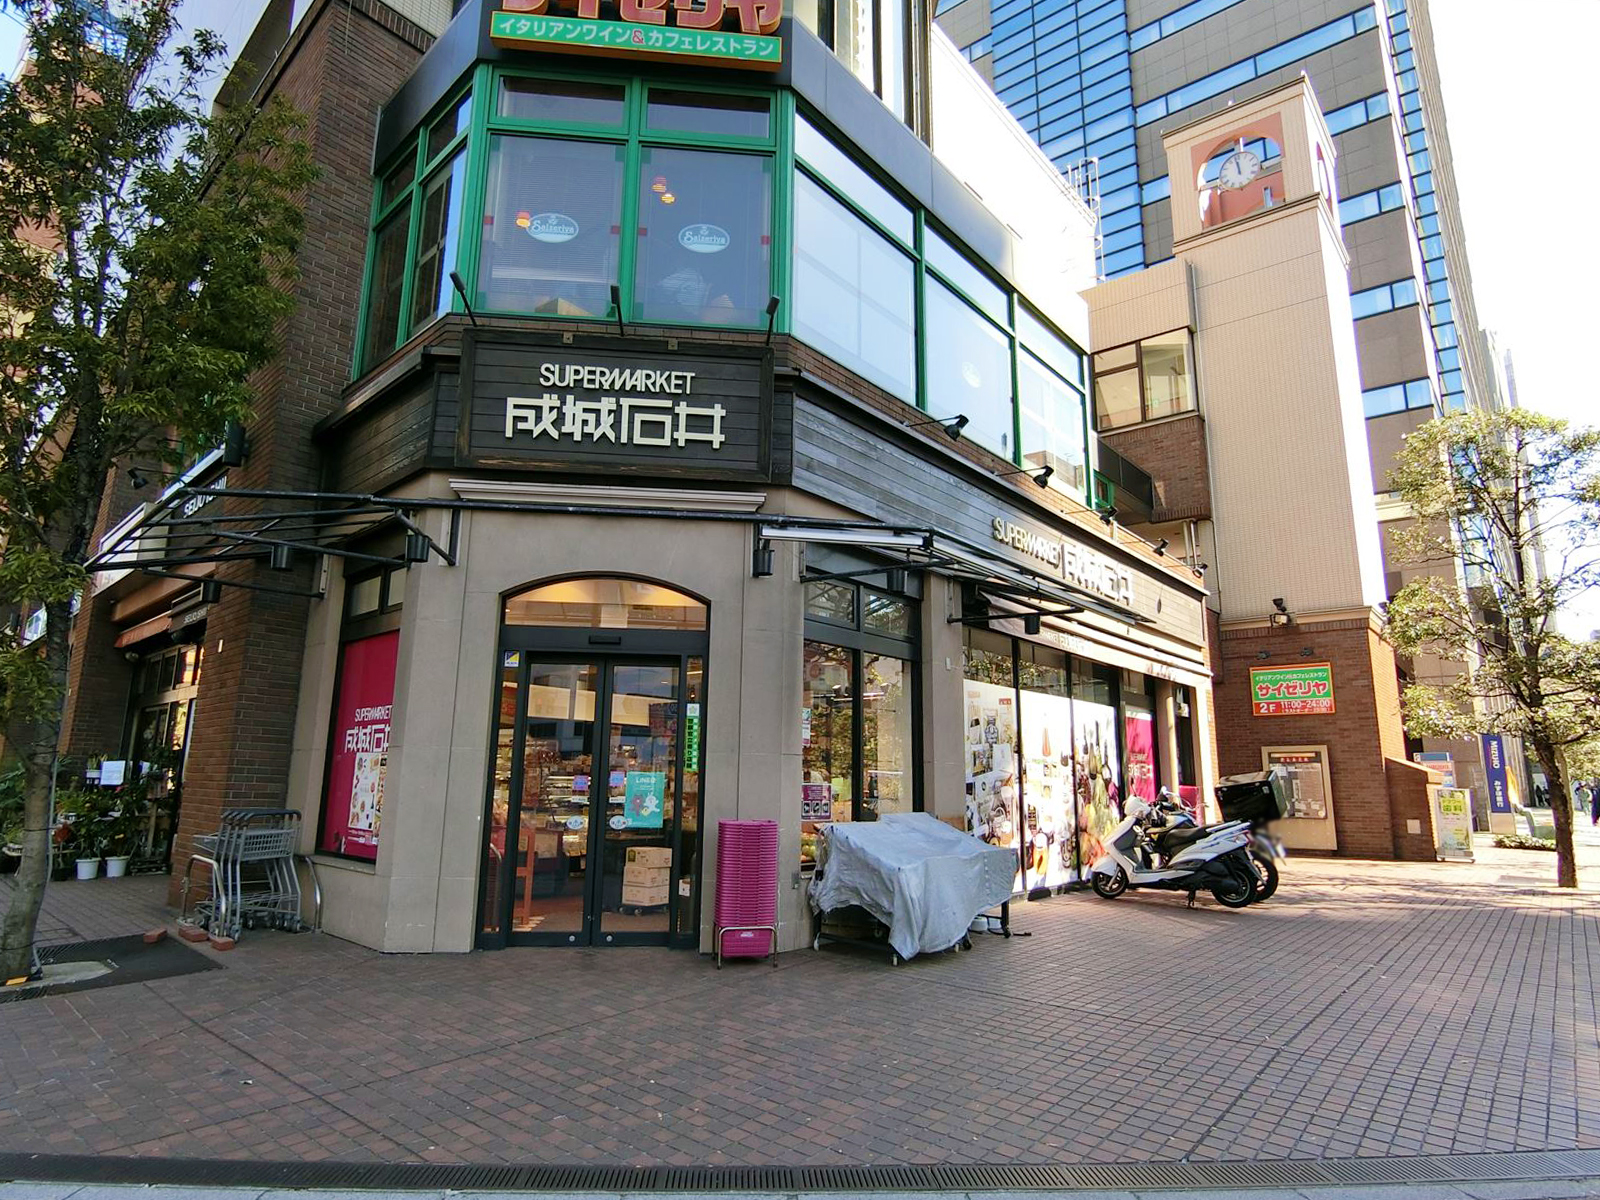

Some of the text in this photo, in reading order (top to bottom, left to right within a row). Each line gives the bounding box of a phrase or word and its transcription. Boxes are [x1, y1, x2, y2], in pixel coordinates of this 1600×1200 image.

[500, 18, 775, 56] イタリアンワイン&カフェレストラン
[539, 363, 695, 394] SUPERMARKET
[505, 394, 726, 449] 成城石井
[993, 516, 1062, 570] SUPERMARKET
[1256, 680, 1328, 698] サイゼリヤ
[1490, 740, 1501, 769] MIZUHO
